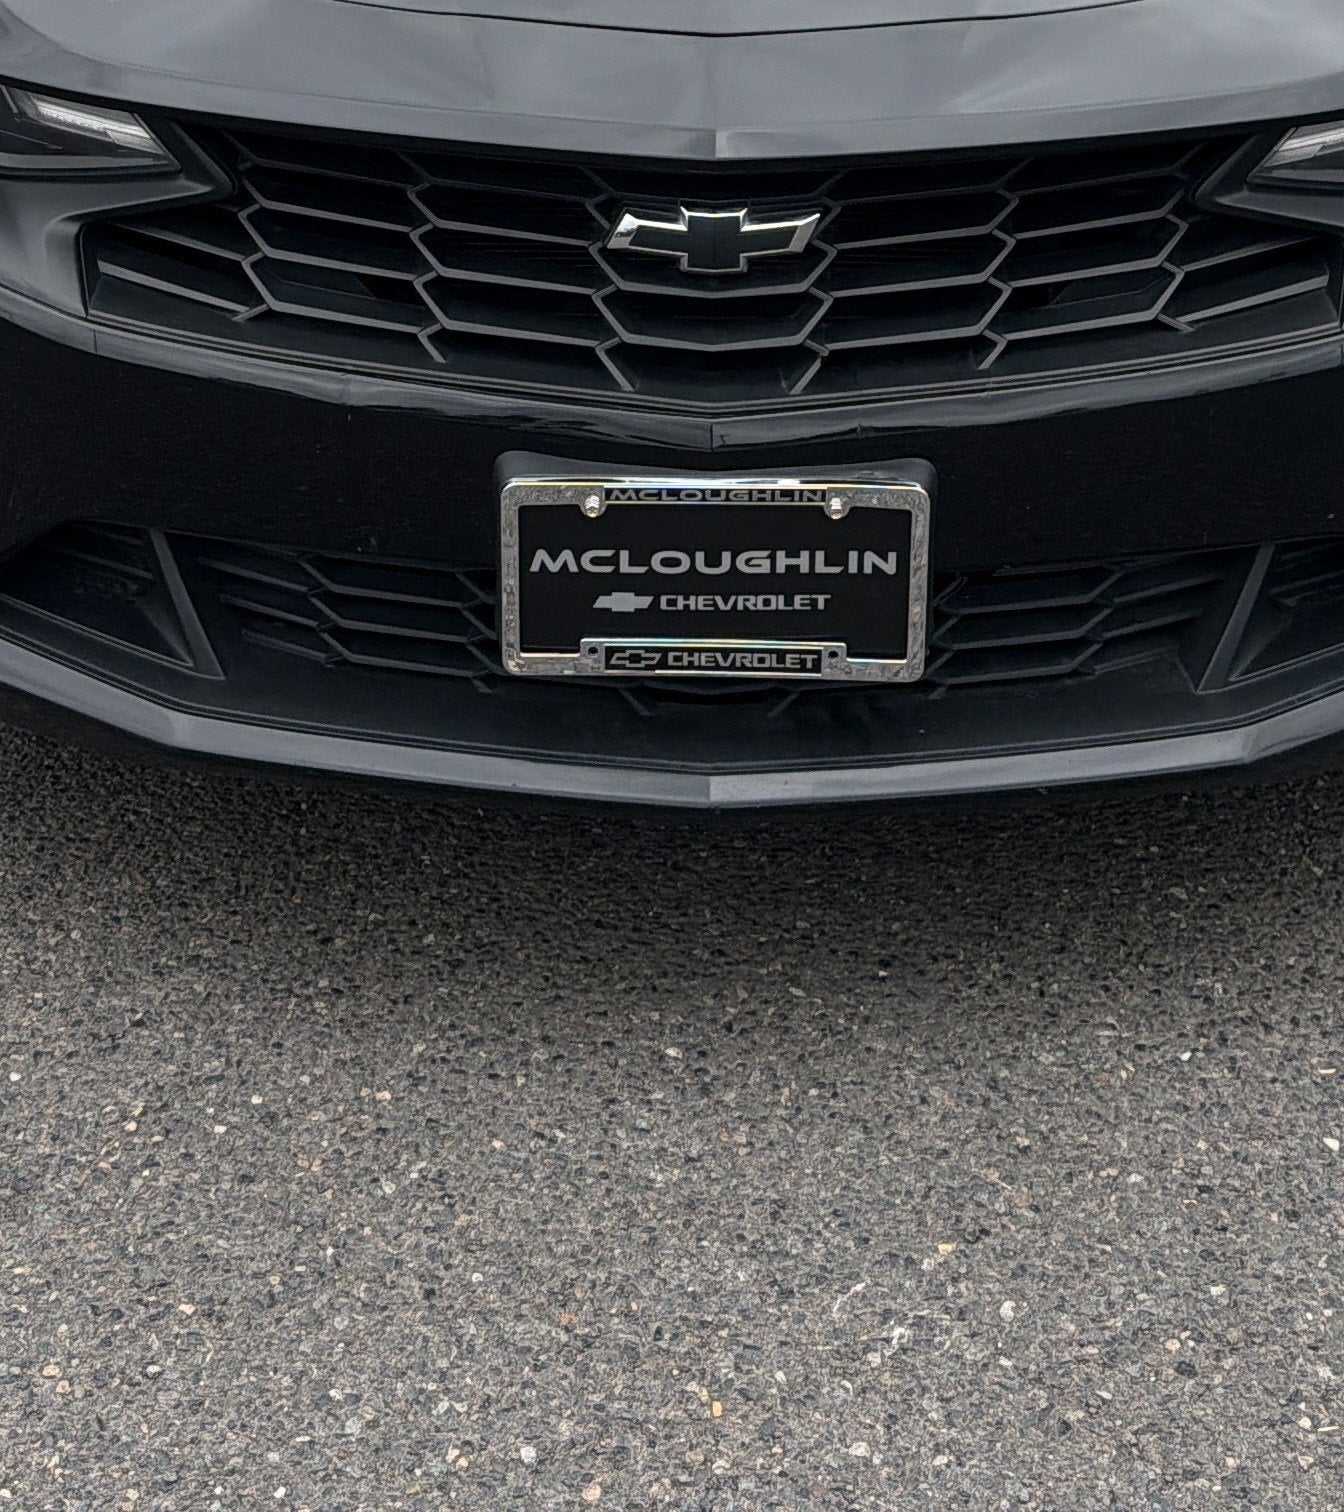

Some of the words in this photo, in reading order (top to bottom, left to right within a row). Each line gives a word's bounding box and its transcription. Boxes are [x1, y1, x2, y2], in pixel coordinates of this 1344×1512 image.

[609, 488, 823, 502] MCLOUGHLIN
[529, 548, 898, 576] MCLOUGHLIN
[659, 593, 832, 612] CHEVROLET
[667, 650, 819, 669] CHEVROLET
